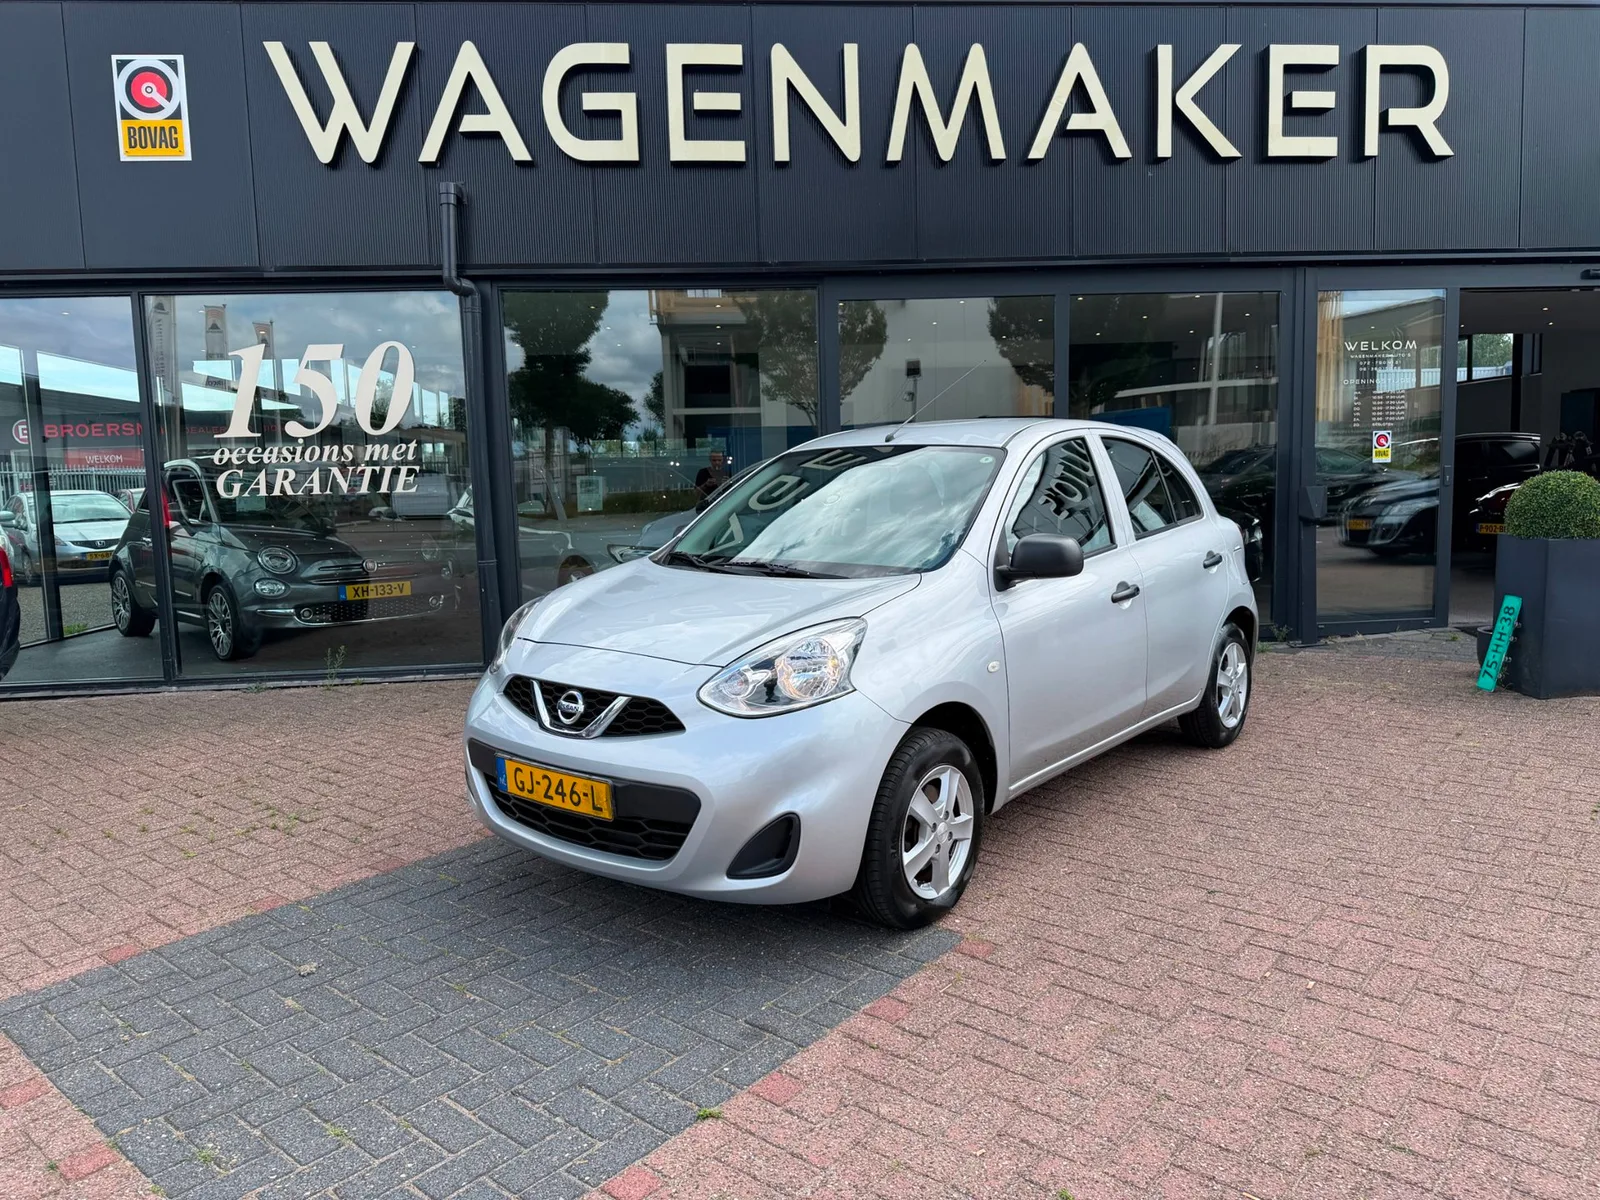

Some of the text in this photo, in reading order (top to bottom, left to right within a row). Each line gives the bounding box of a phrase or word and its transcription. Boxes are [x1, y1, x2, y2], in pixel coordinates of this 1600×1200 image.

[263, 41, 1453, 164] WAGENMAKER
[127, 125, 179, 149] BOVAG
[1344, 340, 1418, 351] WELKOM
[213, 340, 415, 438] 150
[86, 454, 123, 464] WELKOM
[213, 437, 418, 465] occasions met
[216, 465, 420, 500] GARANTIE
[352, 583, 405, 598] XH-133-V
[1482, 606, 1515, 679] 75-HH-38
[513, 767, 603, 812] GJ-246-L
